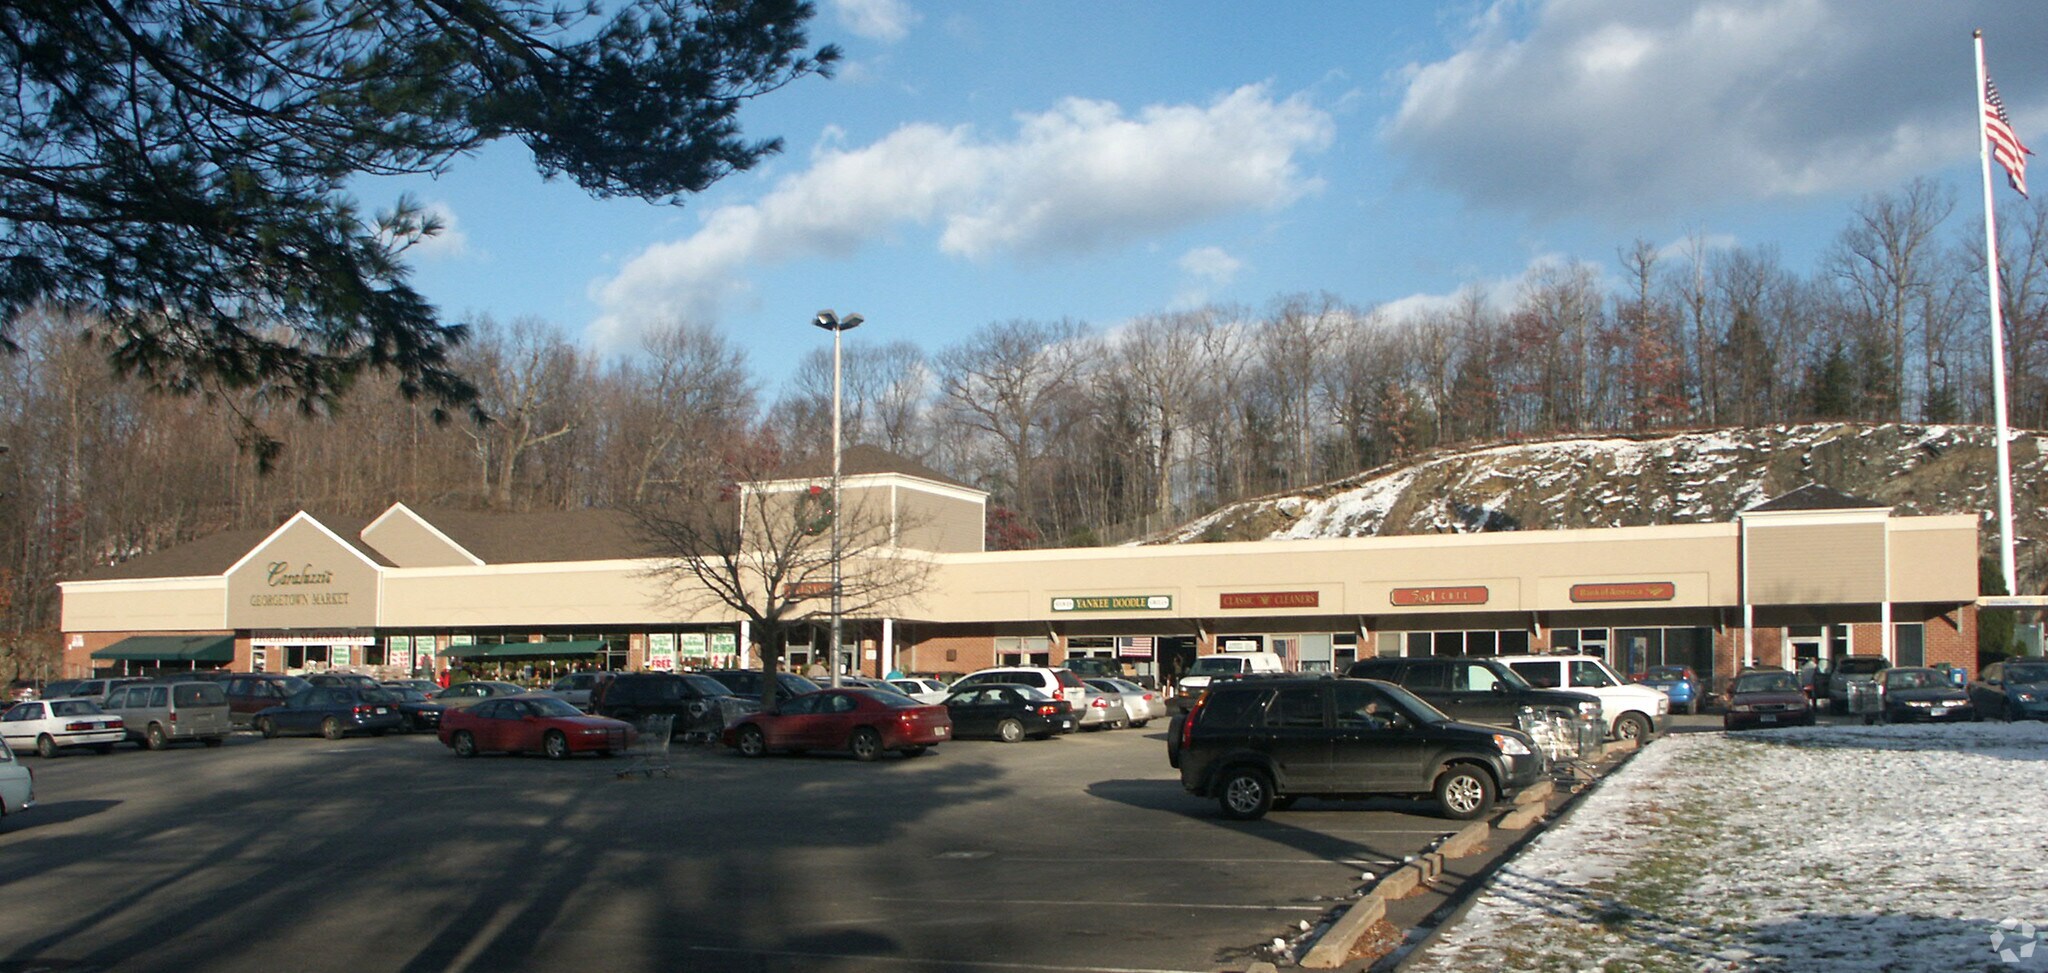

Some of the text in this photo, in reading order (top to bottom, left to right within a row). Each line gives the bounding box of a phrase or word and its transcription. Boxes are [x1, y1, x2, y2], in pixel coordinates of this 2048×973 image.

[250, 592, 349, 607] GEORGETOWN MARKET
[1076, 599, 1109, 609] YANKEE
[1112, 598, 1146, 608] DOODLE
[1222, 595, 1315, 605] CLASSIC CLEANERS
[651, 659, 672, 669] FREE
